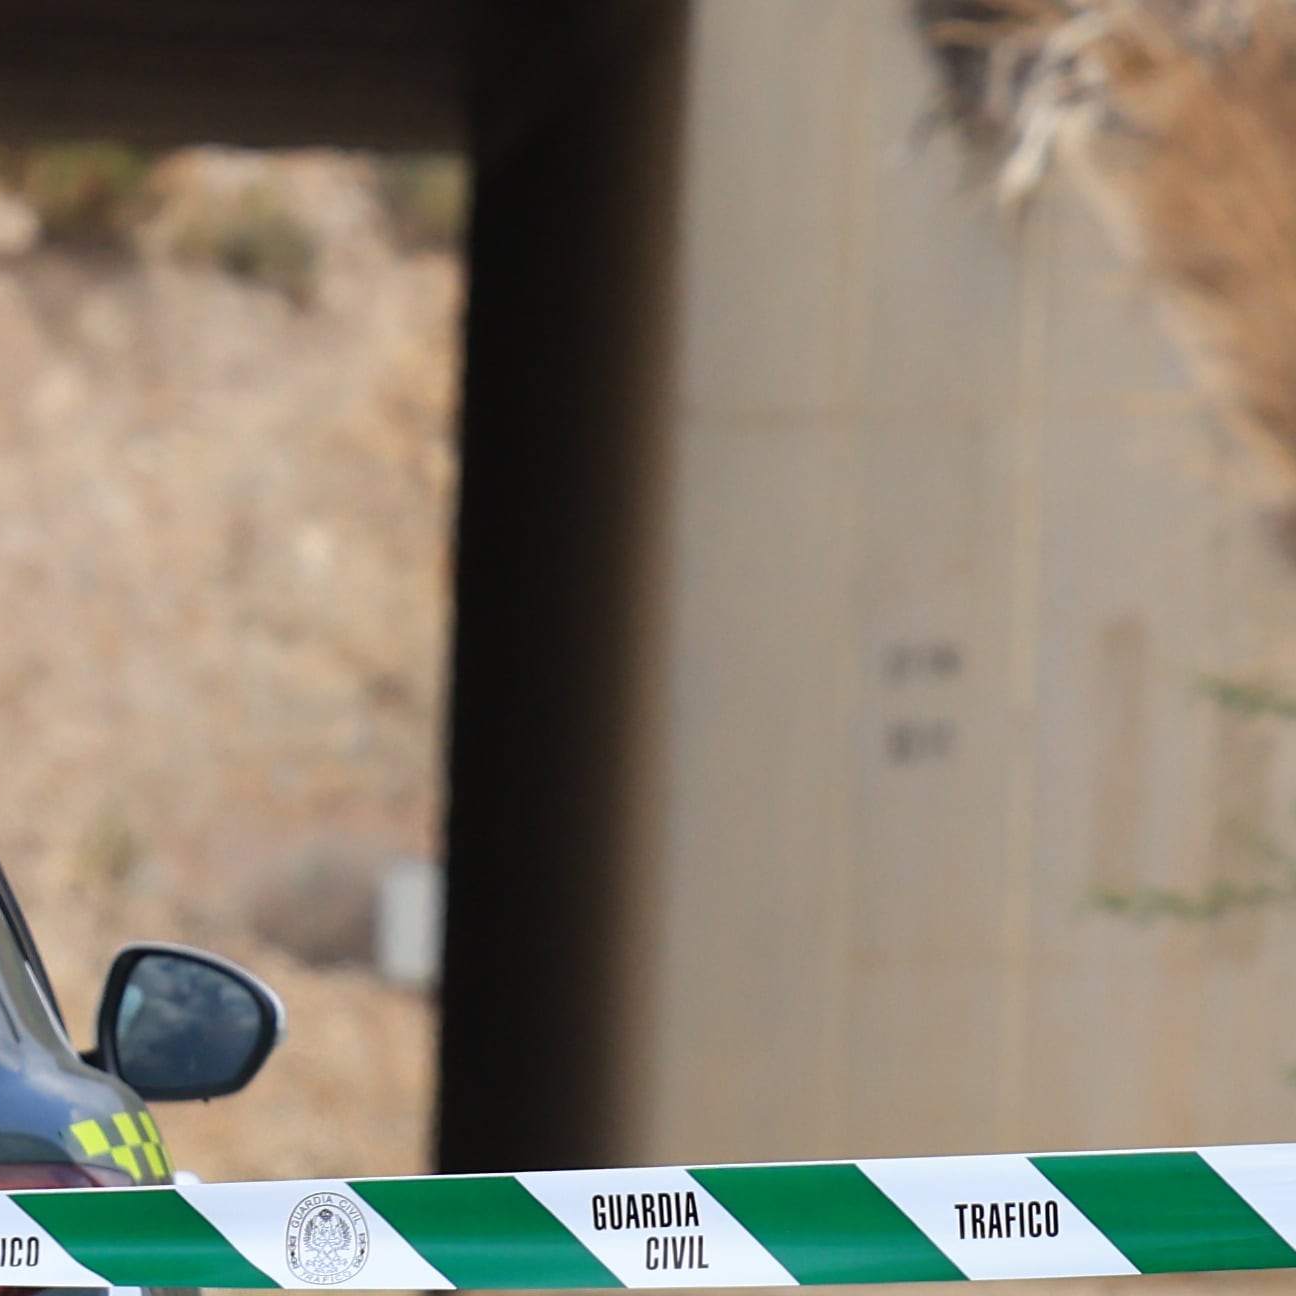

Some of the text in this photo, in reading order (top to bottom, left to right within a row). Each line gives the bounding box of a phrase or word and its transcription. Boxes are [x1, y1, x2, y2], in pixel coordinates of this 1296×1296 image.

[290, 1195, 361, 1229] GUARDIA CIVIL
[592, 1191, 700, 1231] GUARDIA
[954, 1200, 1060, 1239] TRAFICO
[645, 1234, 709, 1271] CIVIL
